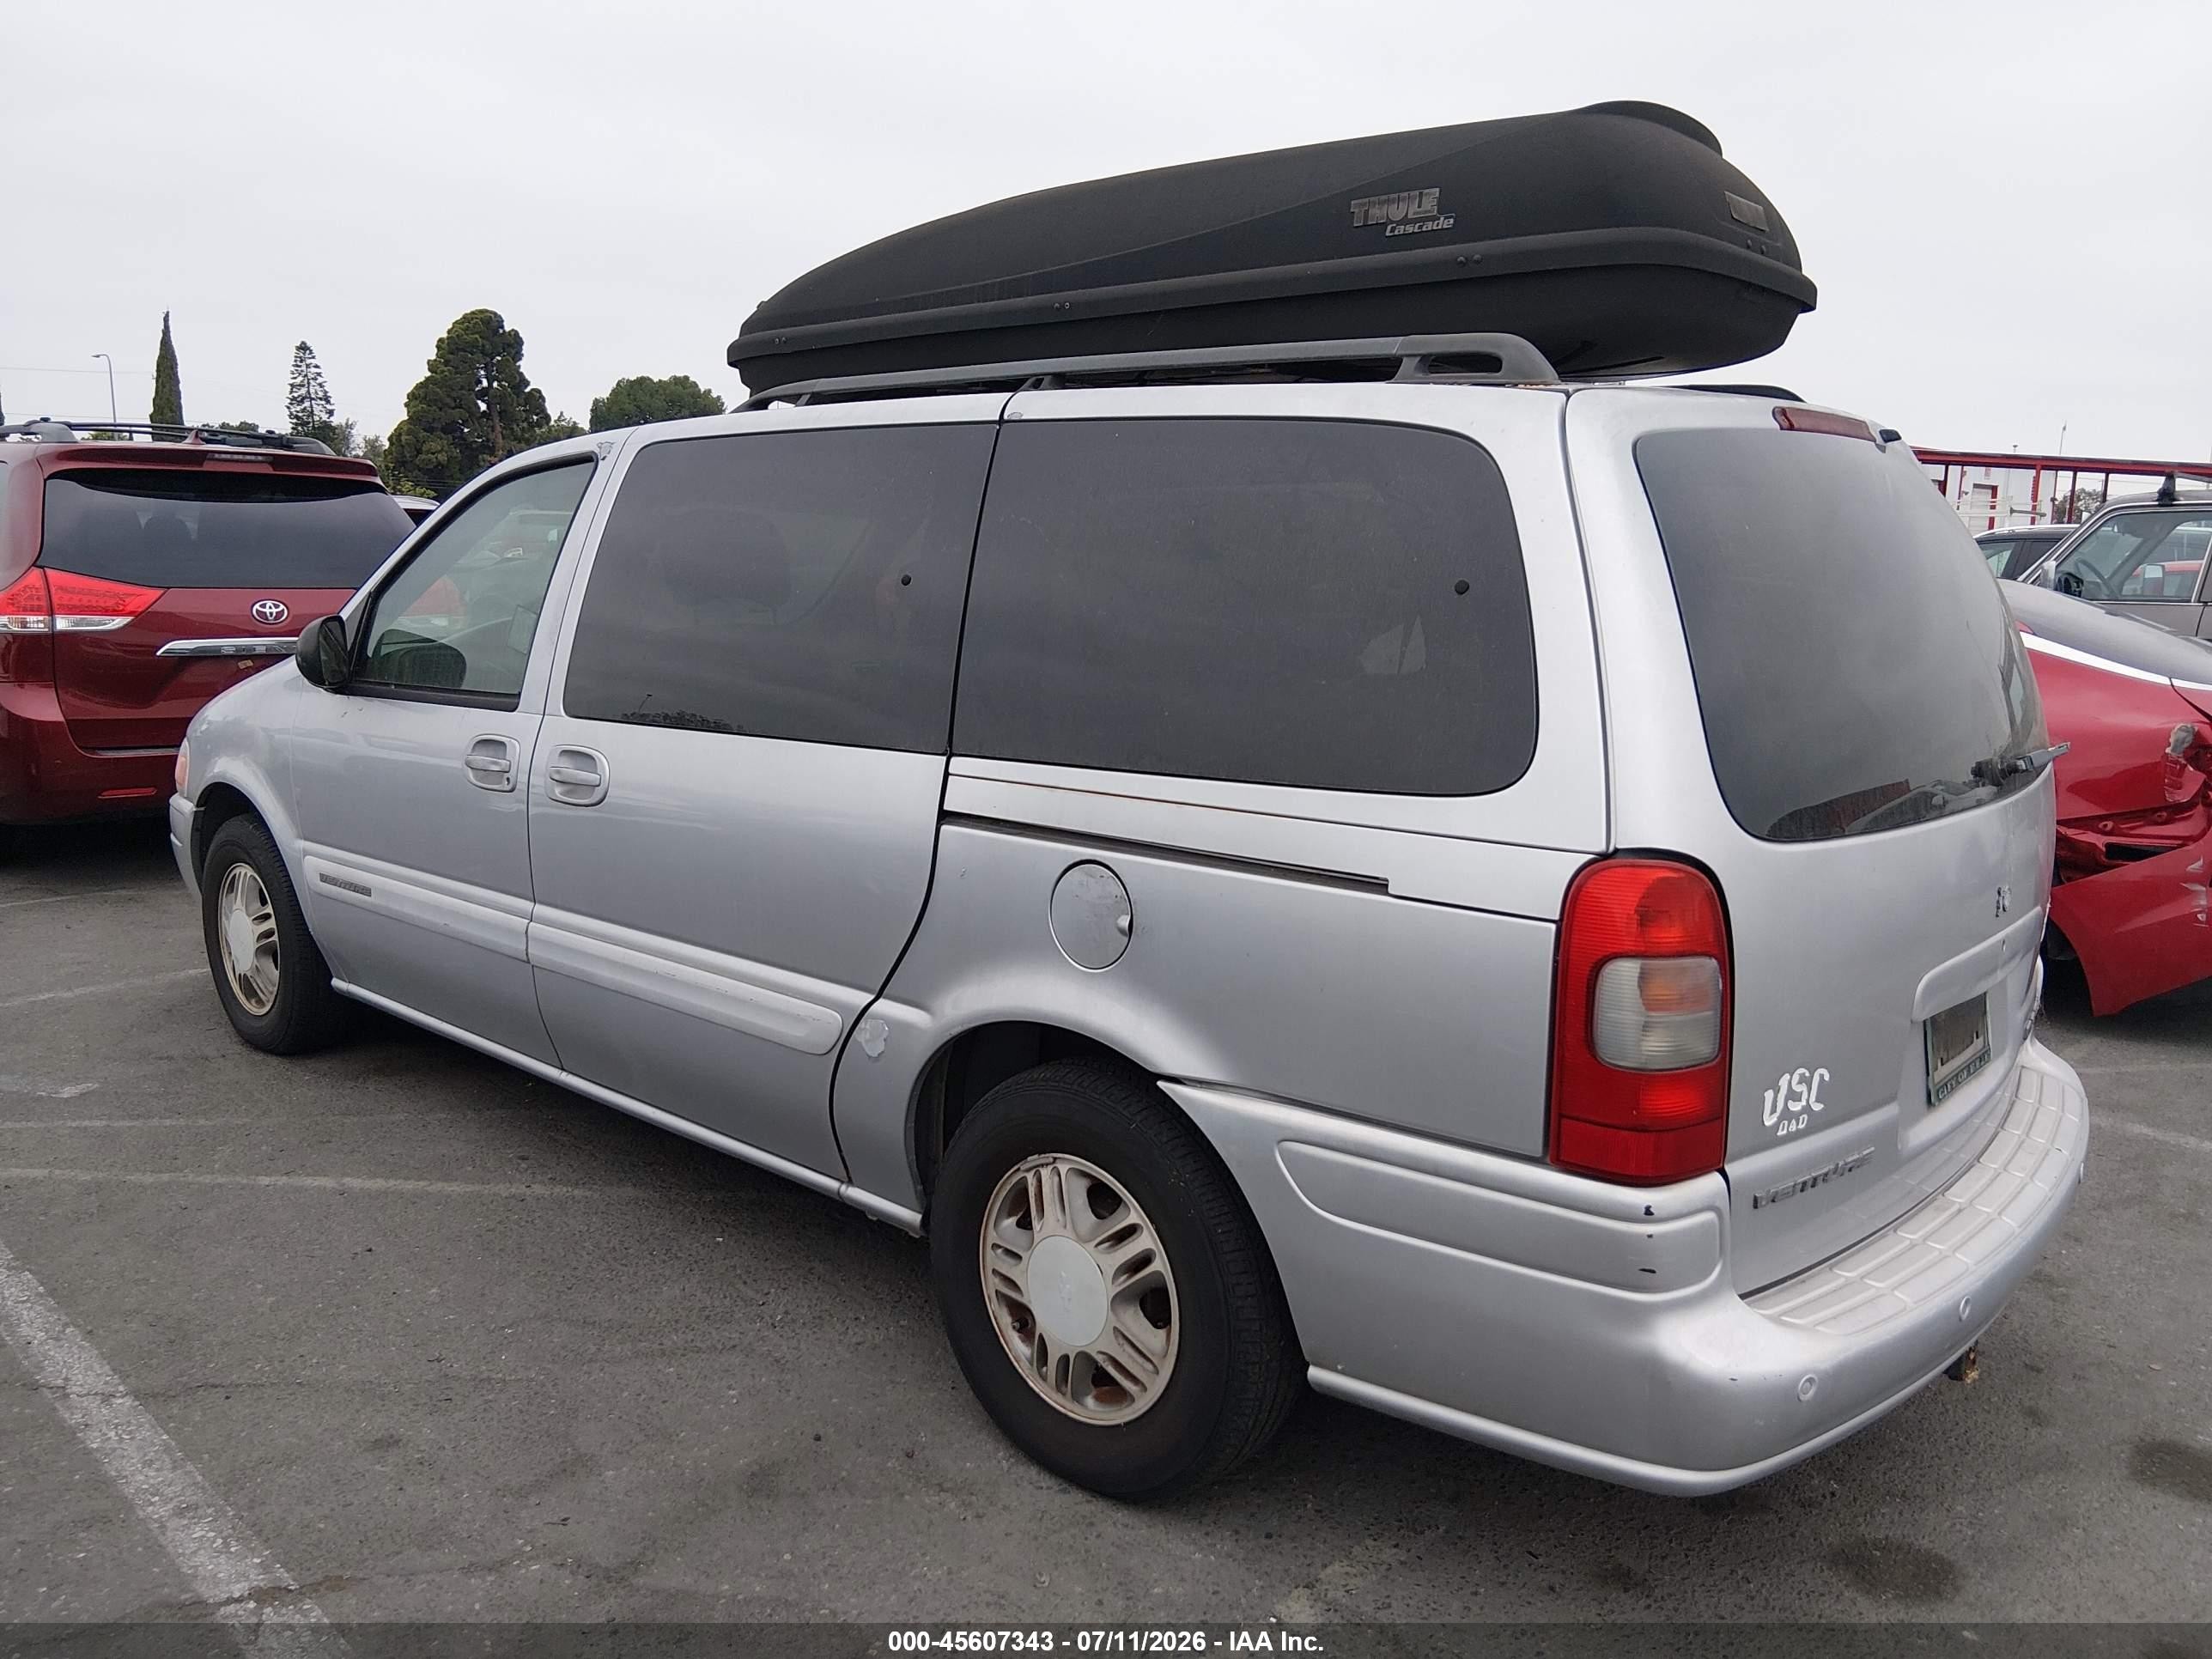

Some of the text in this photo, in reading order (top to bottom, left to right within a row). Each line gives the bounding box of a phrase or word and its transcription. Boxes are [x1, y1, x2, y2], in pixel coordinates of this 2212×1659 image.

[1351, 187, 1440, 227] THULE
[1385, 216, 1455, 237] Cascade
[1763, 1067, 1830, 1127] USC
[1938, 1077, 1957, 1099] CITY
[1777, 1114, 1808, 1136] DAD
